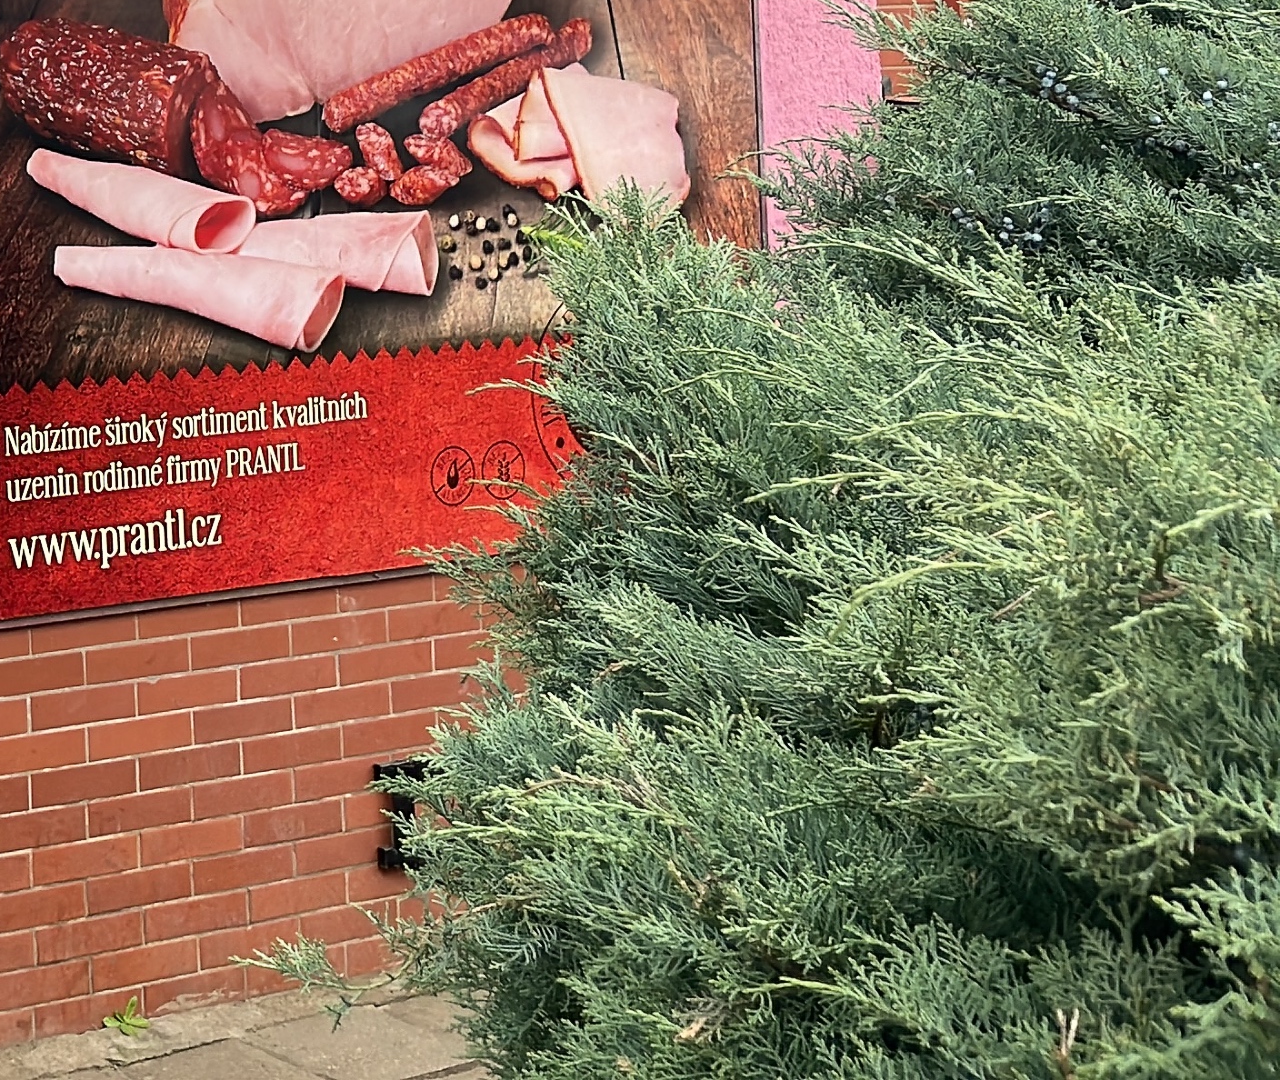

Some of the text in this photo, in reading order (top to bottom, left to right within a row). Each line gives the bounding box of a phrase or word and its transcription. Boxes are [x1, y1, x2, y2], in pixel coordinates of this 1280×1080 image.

[3, 391, 368, 456] Nabízíme široký sortiment kvalitních
[5, 442, 306, 502] uzenin rodinné firmy PRANTL
[7, 508, 223, 569] www.prantl.cz
